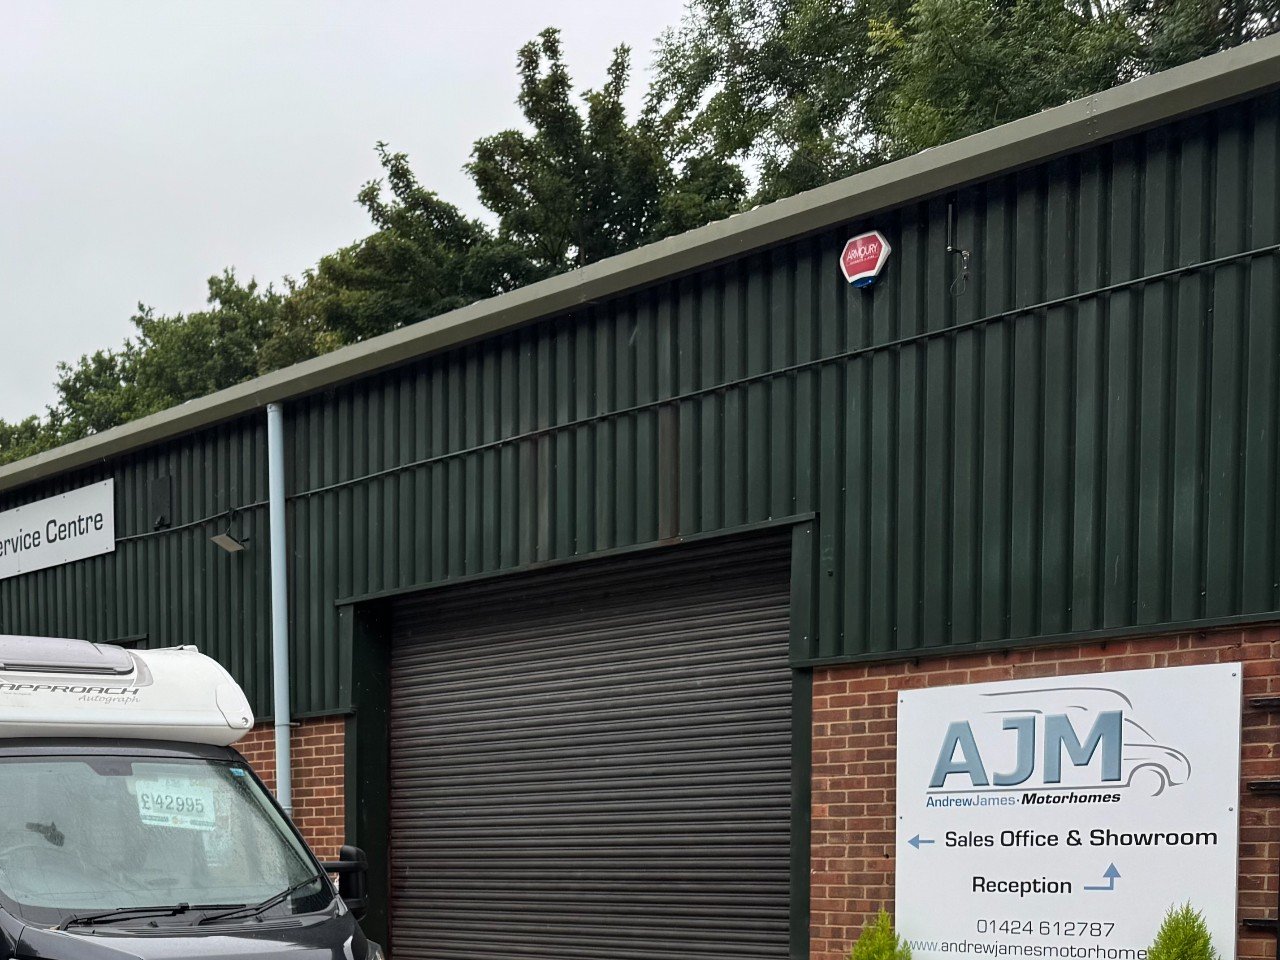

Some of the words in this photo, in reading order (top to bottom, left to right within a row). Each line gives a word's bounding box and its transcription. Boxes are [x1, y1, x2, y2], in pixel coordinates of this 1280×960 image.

[847, 243, 879, 261] ARMOURY
[46, 512, 104, 544] Centre
[78, 694, 141, 705] Autograph
[928, 709, 1123, 789] AJM
[945, 830, 995, 847] Sales
[1000, 830, 1059, 847] Office
[1066, 829, 1082, 846] &
[1089, 828, 1219, 846] Showroom
[972, 876, 1073, 897] Reception
[977, 919, 1034, 935] 01424
[1039, 921, 1115, 938] 612787
